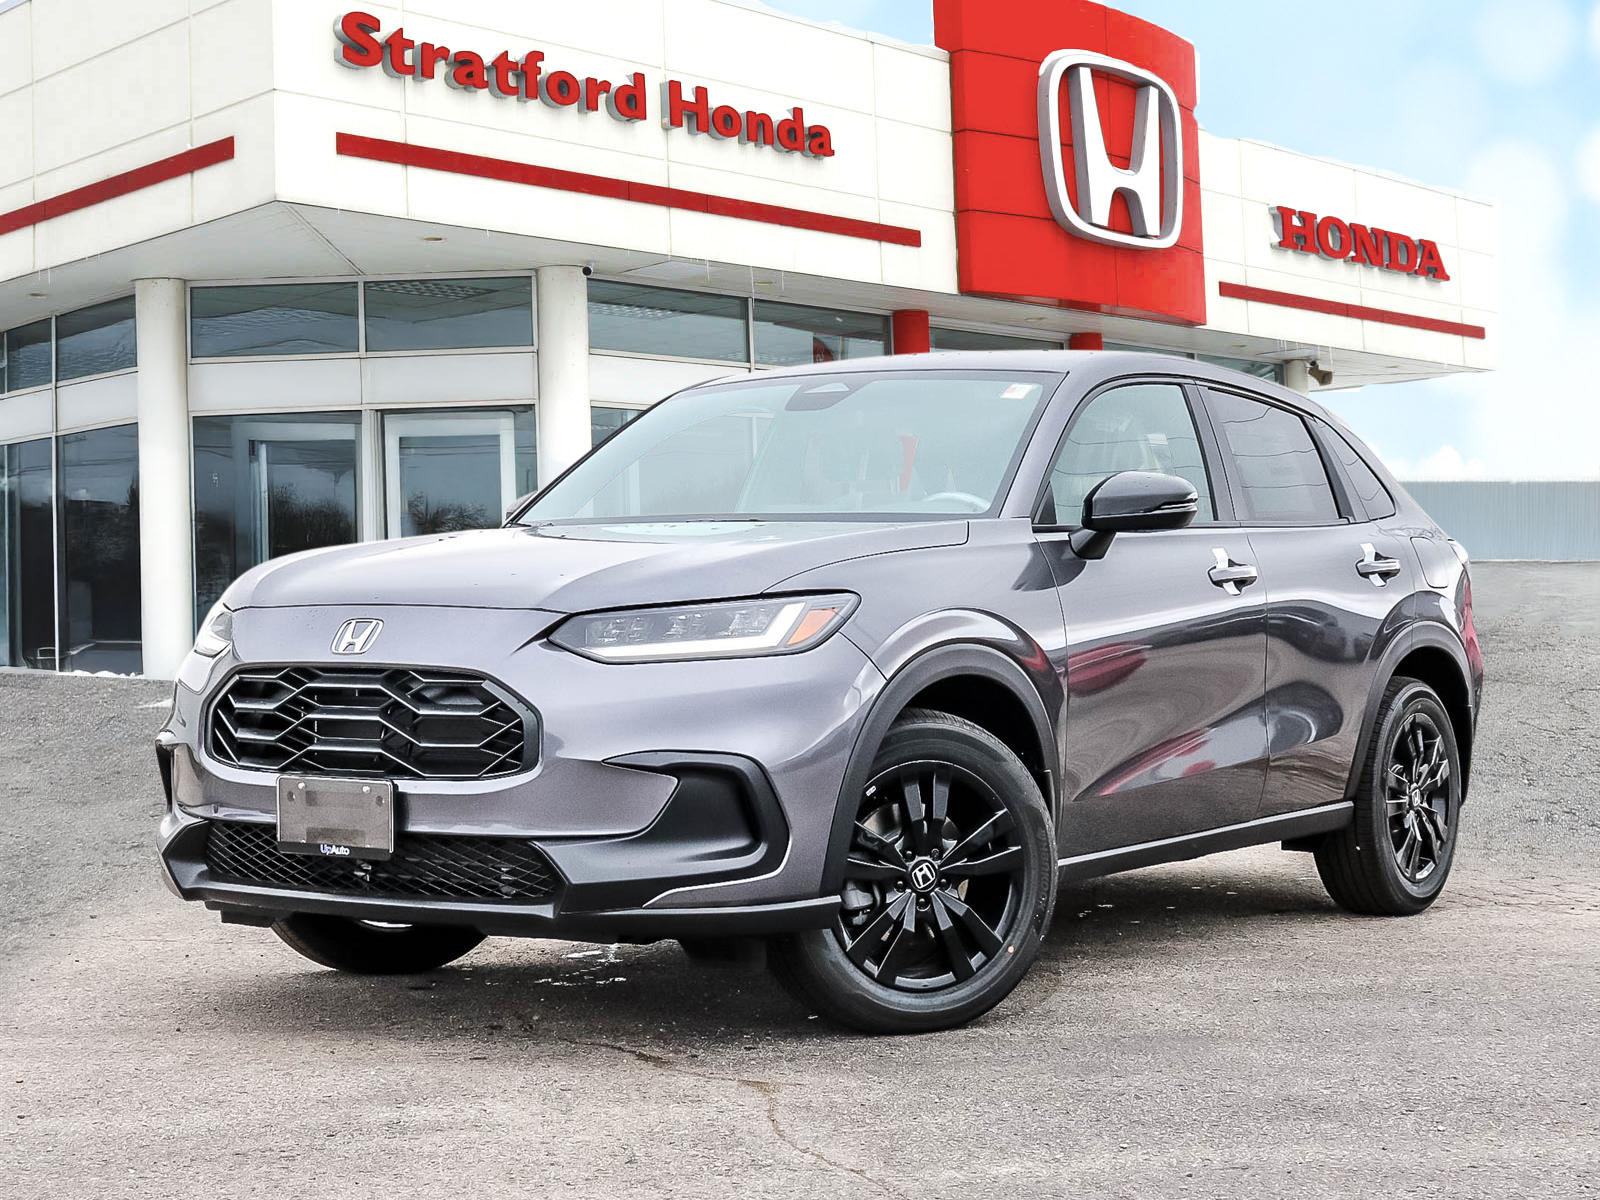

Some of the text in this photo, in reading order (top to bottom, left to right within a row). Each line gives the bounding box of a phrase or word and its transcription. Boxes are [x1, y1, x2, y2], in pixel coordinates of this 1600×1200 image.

[337, 11, 835, 157] Stratford Honda
[1273, 205, 1450, 281] HONDA
[320, 844, 350, 856] UpAuto
